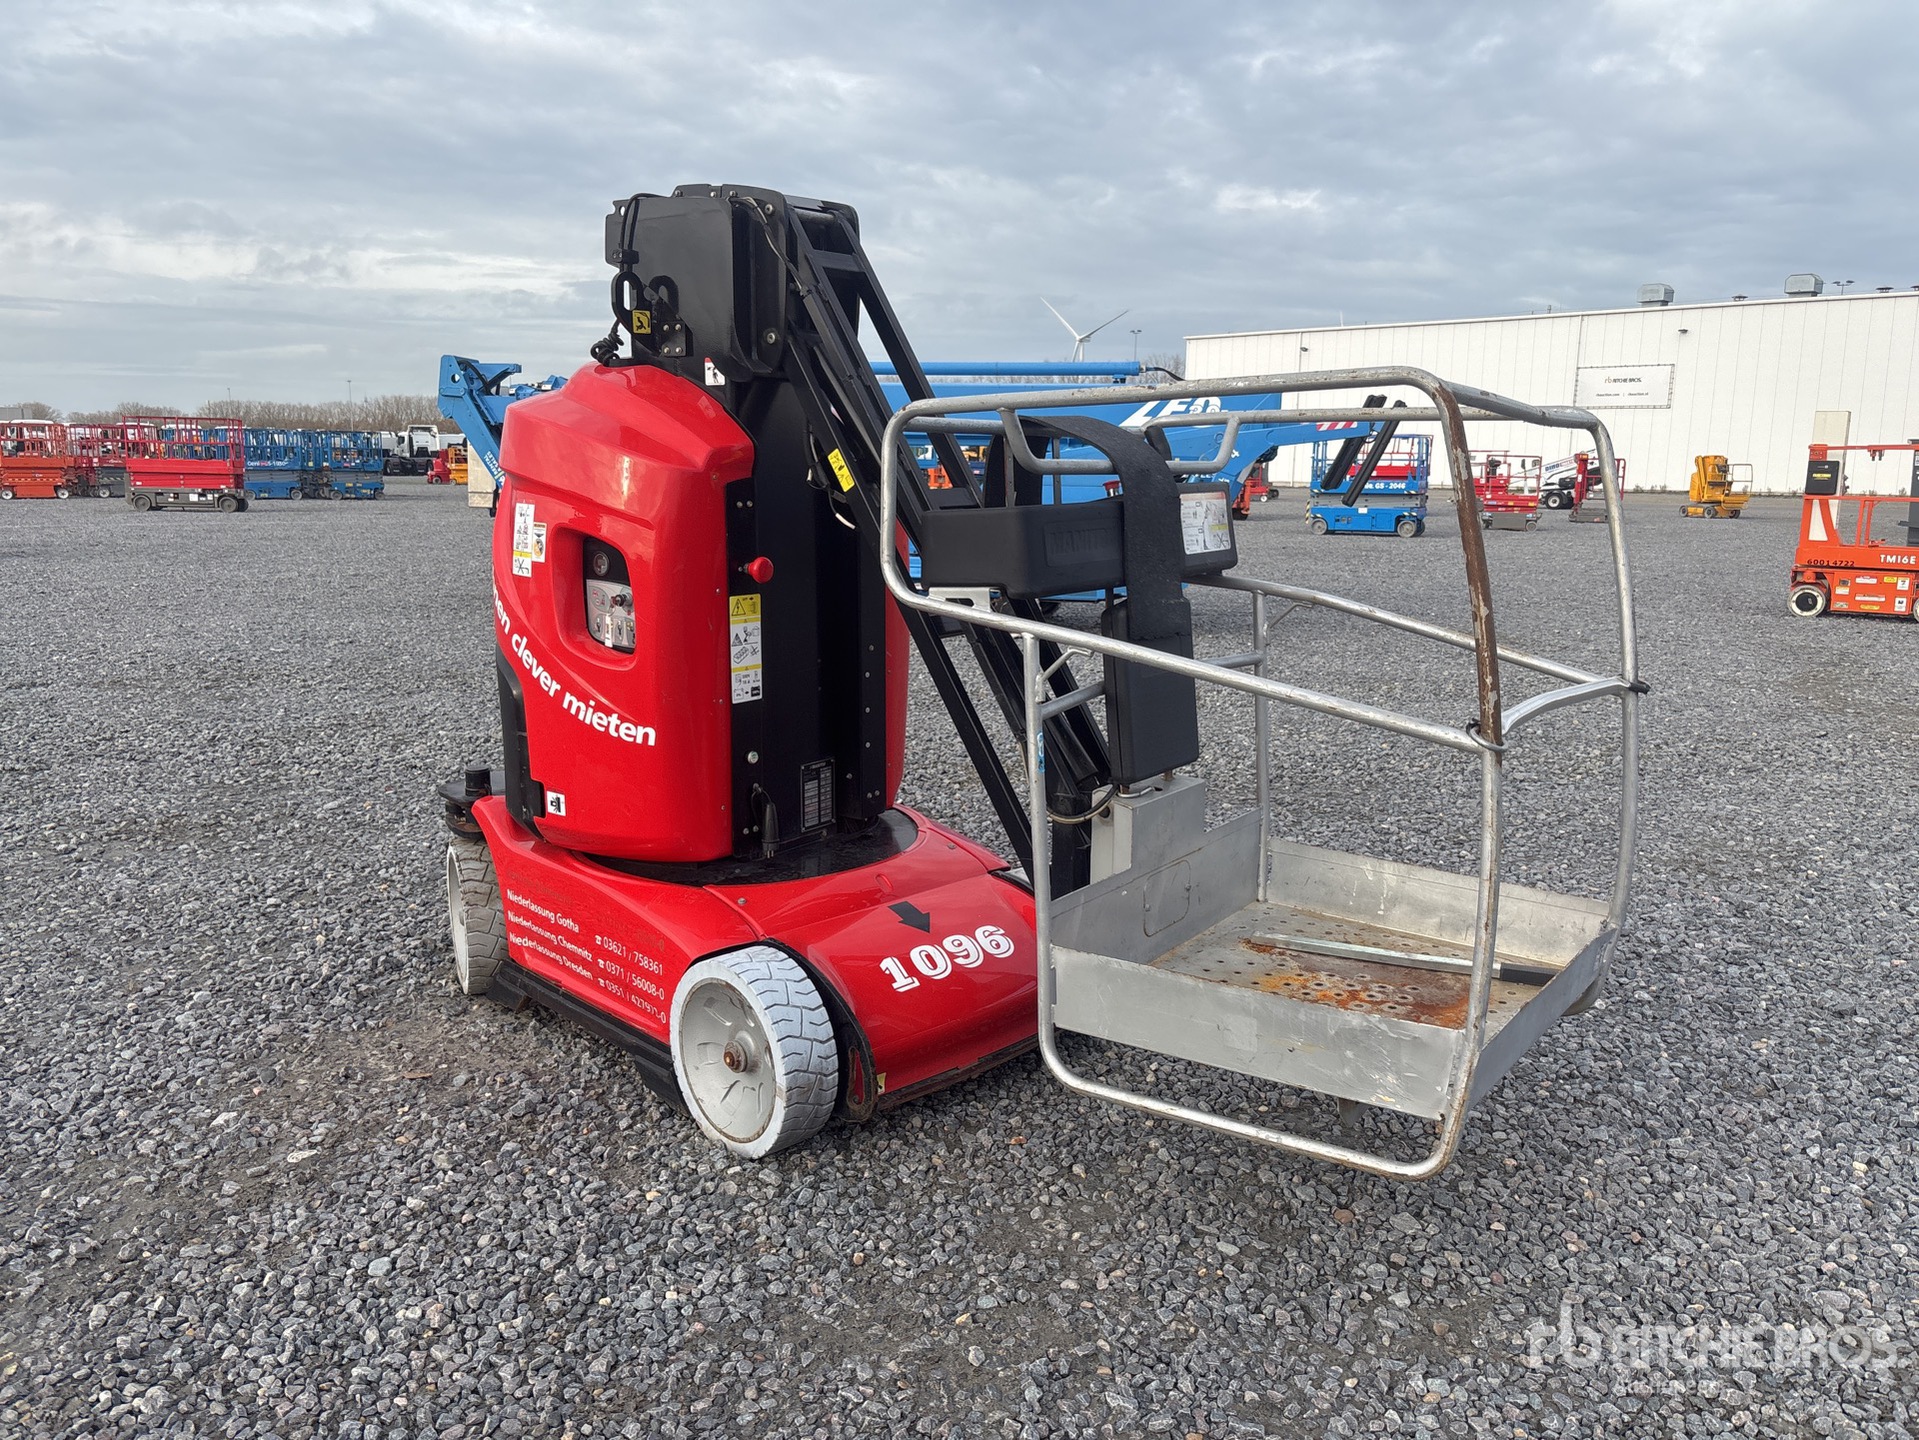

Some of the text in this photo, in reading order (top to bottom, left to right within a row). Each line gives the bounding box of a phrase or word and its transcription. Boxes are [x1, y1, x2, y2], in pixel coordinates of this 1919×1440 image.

[1807, 559, 1855, 567] 60014722
[1880, 554, 1917, 565] TM16E
[511, 632, 562, 698] clever
[562, 691, 657, 747] mieten
[506, 888, 556, 924] Niederlassung
[556, 913, 580, 934] Gotha
[603, 937, 626, 958] 03621
[633, 951, 664, 976] 758361
[507, 910, 558, 945] Niederlassung
[557, 935, 593, 962] Chemnitz
[605, 961, 625, 980] 0371
[631, 973, 665, 1000] 56008-0
[509, 931, 562, 966] Niederlassung
[562, 955, 594, 981] Dresden
[605, 980, 625, 998] 0351
[879, 924, 1015, 993] 1096
